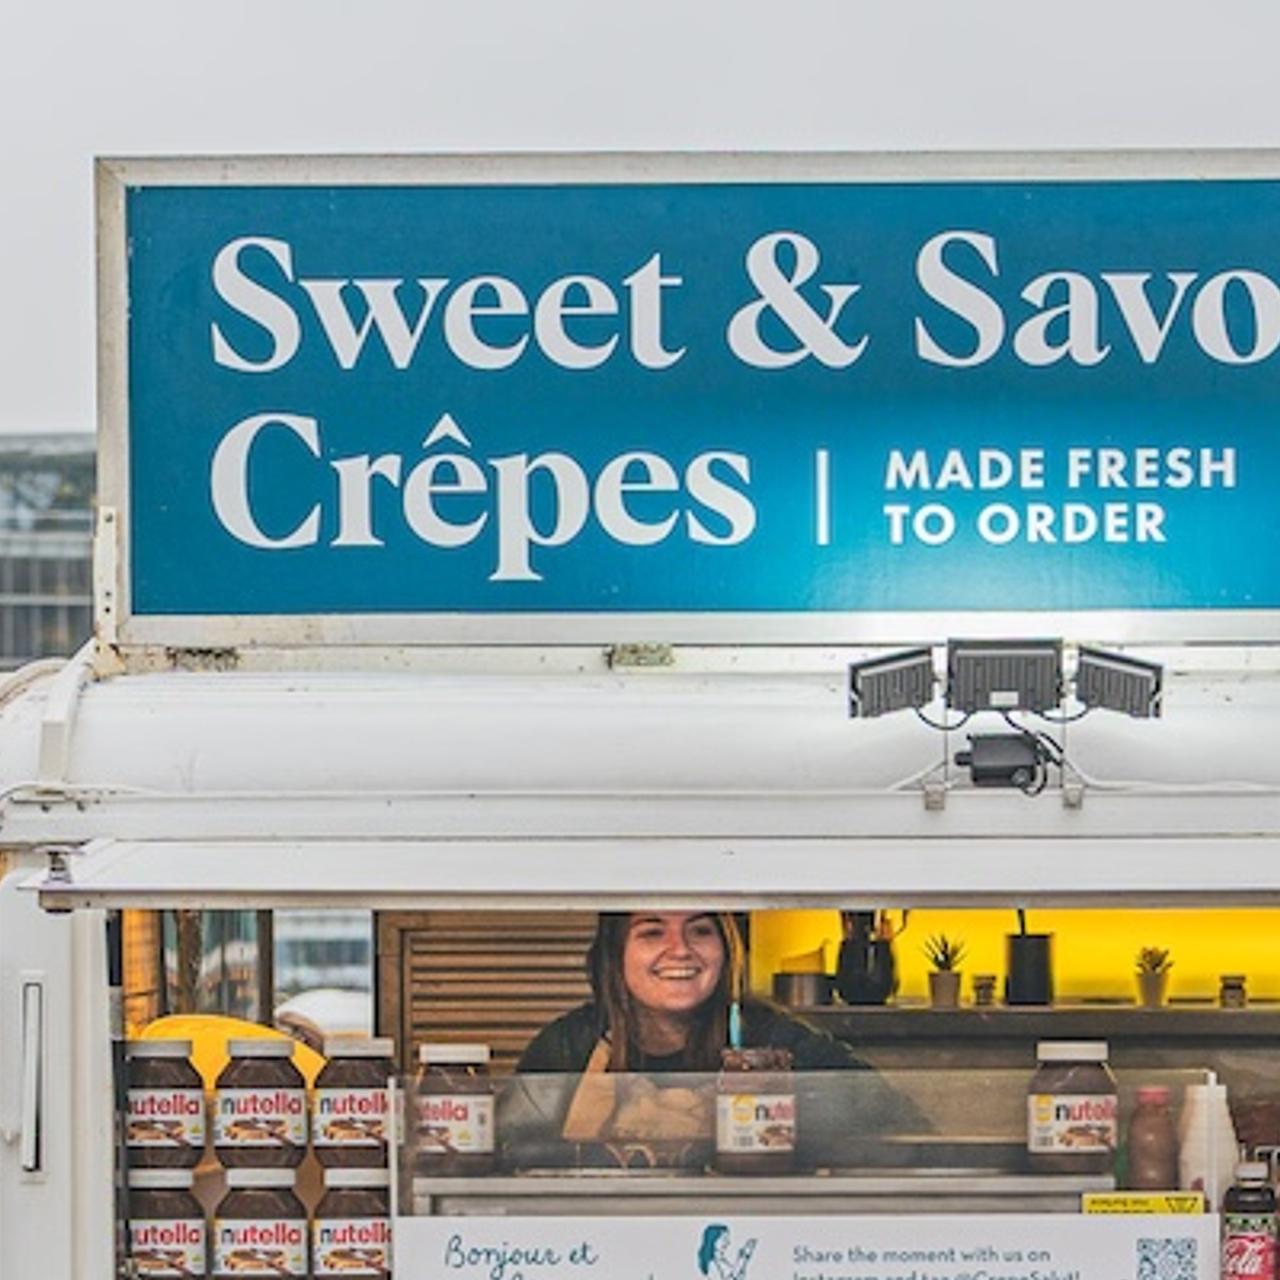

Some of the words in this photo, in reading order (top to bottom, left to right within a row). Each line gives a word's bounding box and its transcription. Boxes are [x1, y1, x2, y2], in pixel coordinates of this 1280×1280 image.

[211, 236, 687, 373] Sweet
[727, 231, 869, 369] &
[884, 448, 1045, 491] MADE
[1068, 447, 1236, 489] FRESH
[210, 412, 757, 581] Crêpes
[883, 503, 956, 546] TO
[976, 502, 1167, 551] ORDER
[221, 1091, 302, 1116] nutella
[221, 1223, 303, 1247] nutella
[445, 1234, 560, 1280] Bonjour
[569, 1242, 599, 1265] et
[793, 1245, 844, 1264] Share
[847, 1245, 878, 1264] the
[882, 1247, 956, 1264] moment
[960, 1245, 1000, 1263] with
[1002, 1250, 1024, 1263] us
[1026, 1250, 1051, 1263] on
